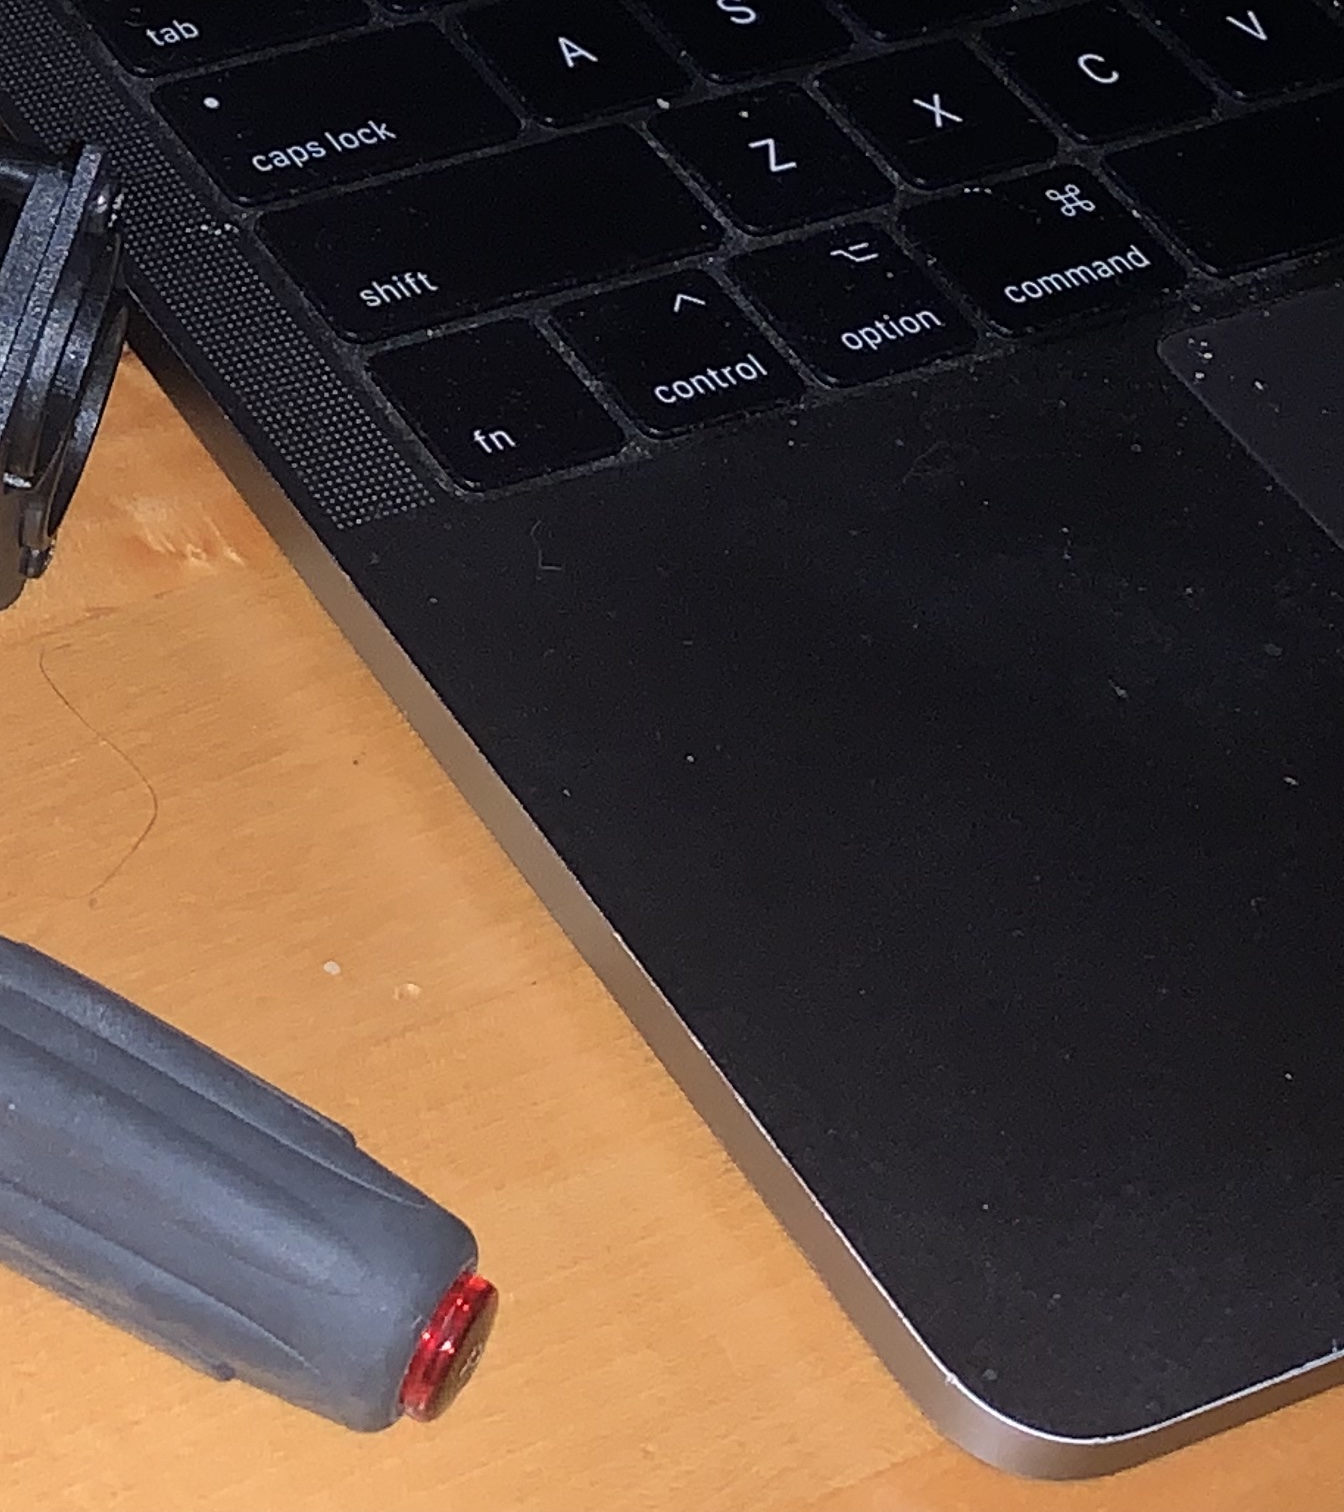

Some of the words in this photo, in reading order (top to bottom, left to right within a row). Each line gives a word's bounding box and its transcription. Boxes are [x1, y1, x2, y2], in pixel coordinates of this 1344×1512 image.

[146, 19, 199, 47] tab
[1225, 9, 1268, 41] V
[557, 35, 598, 68] A
[1076, 53, 1120, 85] C
[913, 92, 963, 129] X
[251, 139, 327, 175] caps
[325, 118, 398, 153] lock
[749, 137, 797, 174] Z
[359, 269, 439, 309] shift
[1003, 245, 1151, 305] command
[840, 306, 942, 352] option
[653, 353, 767, 405] control
[472, 424, 516, 455] fn
